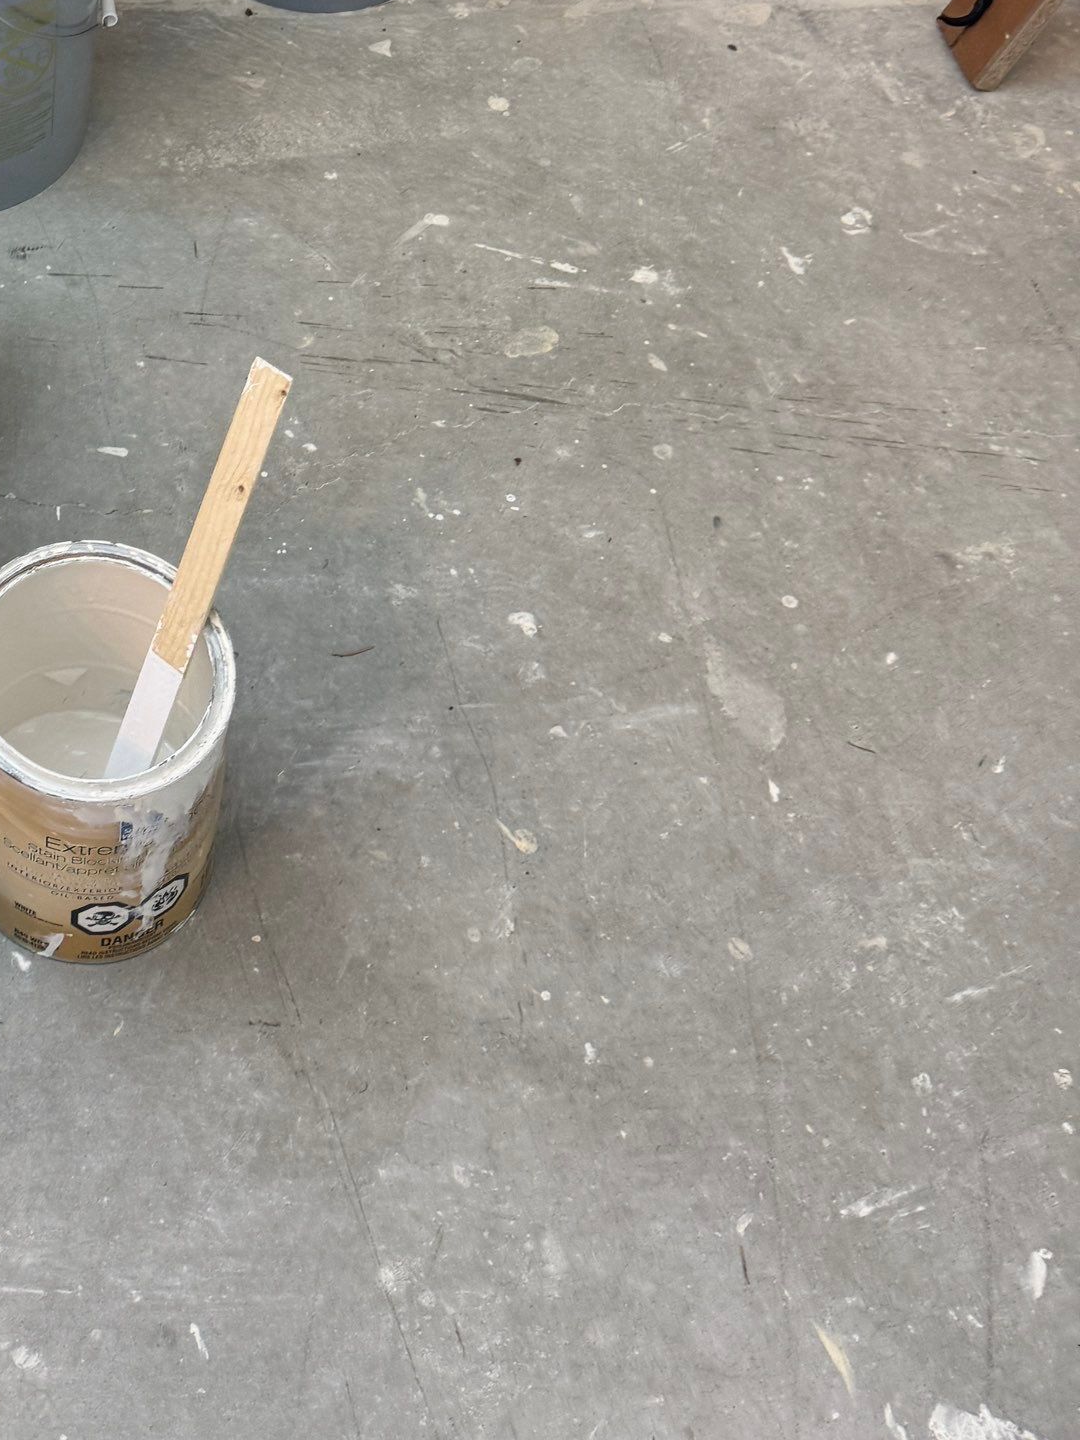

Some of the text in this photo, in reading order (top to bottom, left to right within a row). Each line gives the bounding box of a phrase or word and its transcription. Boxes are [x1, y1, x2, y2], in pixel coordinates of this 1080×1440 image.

[28, 841, 67, 863] Stain
[50, 890, 70, 901] OIL
[100, 918, 164, 947] DANGER
